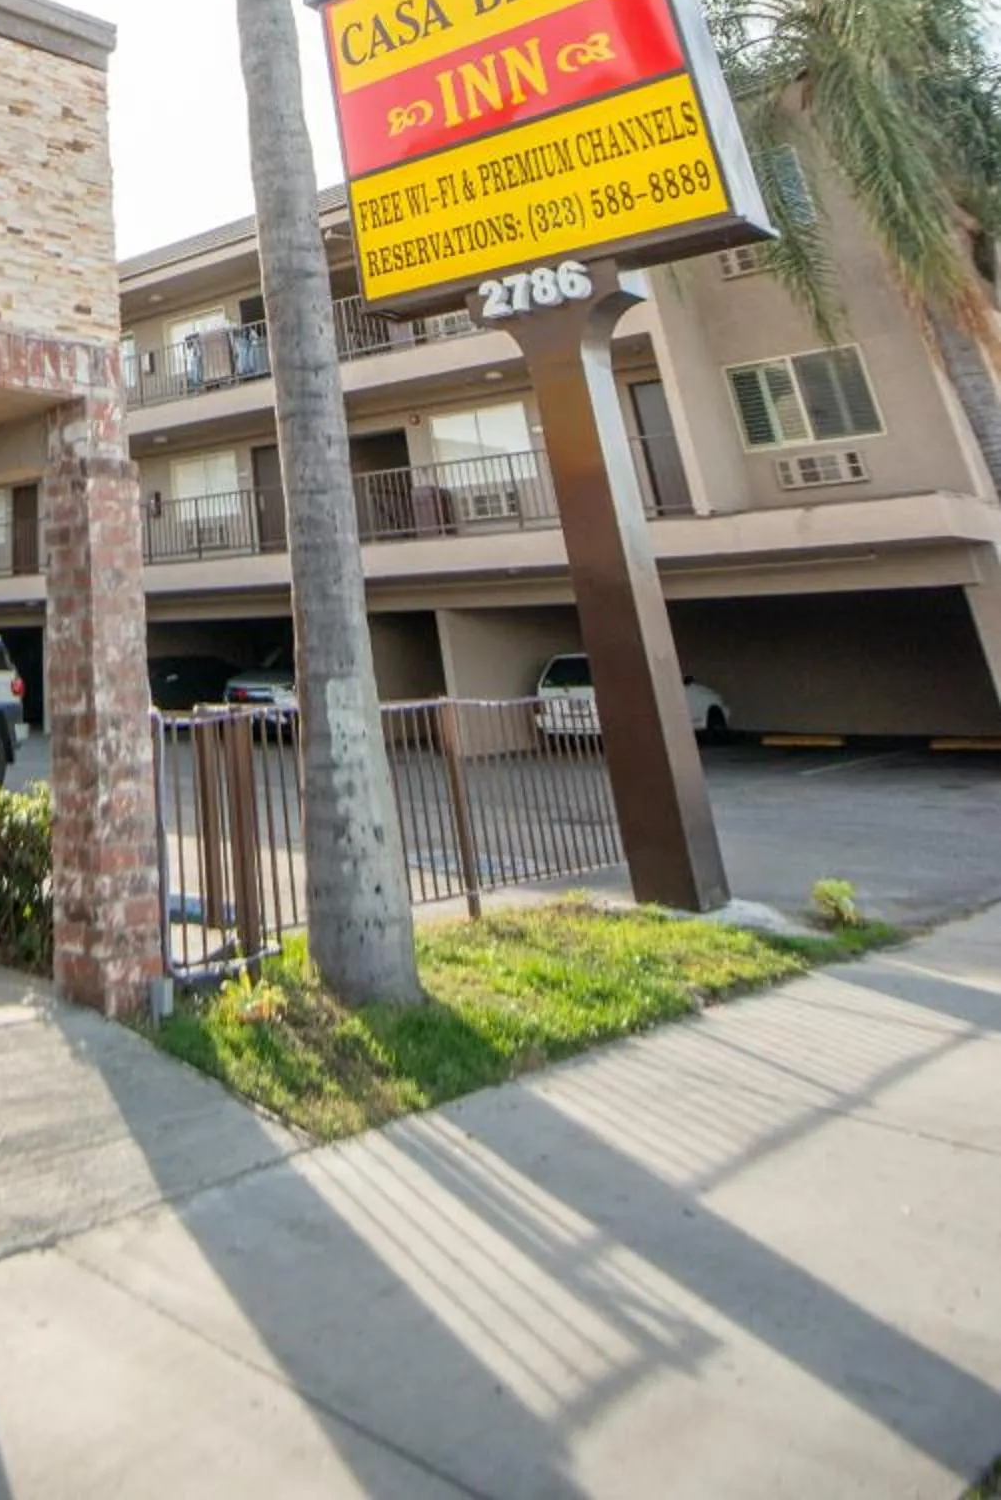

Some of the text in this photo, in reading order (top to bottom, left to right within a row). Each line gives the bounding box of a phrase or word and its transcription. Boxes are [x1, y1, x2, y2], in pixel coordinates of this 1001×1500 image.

[434, 36, 549, 129] INN
[358, 99, 698, 233] FREE WI-FI & PREMIUM CHANNELS
[366, 158, 712, 277] RESERVATIONS: (323) 588-8889
[478, 260, 592, 319] 2786
